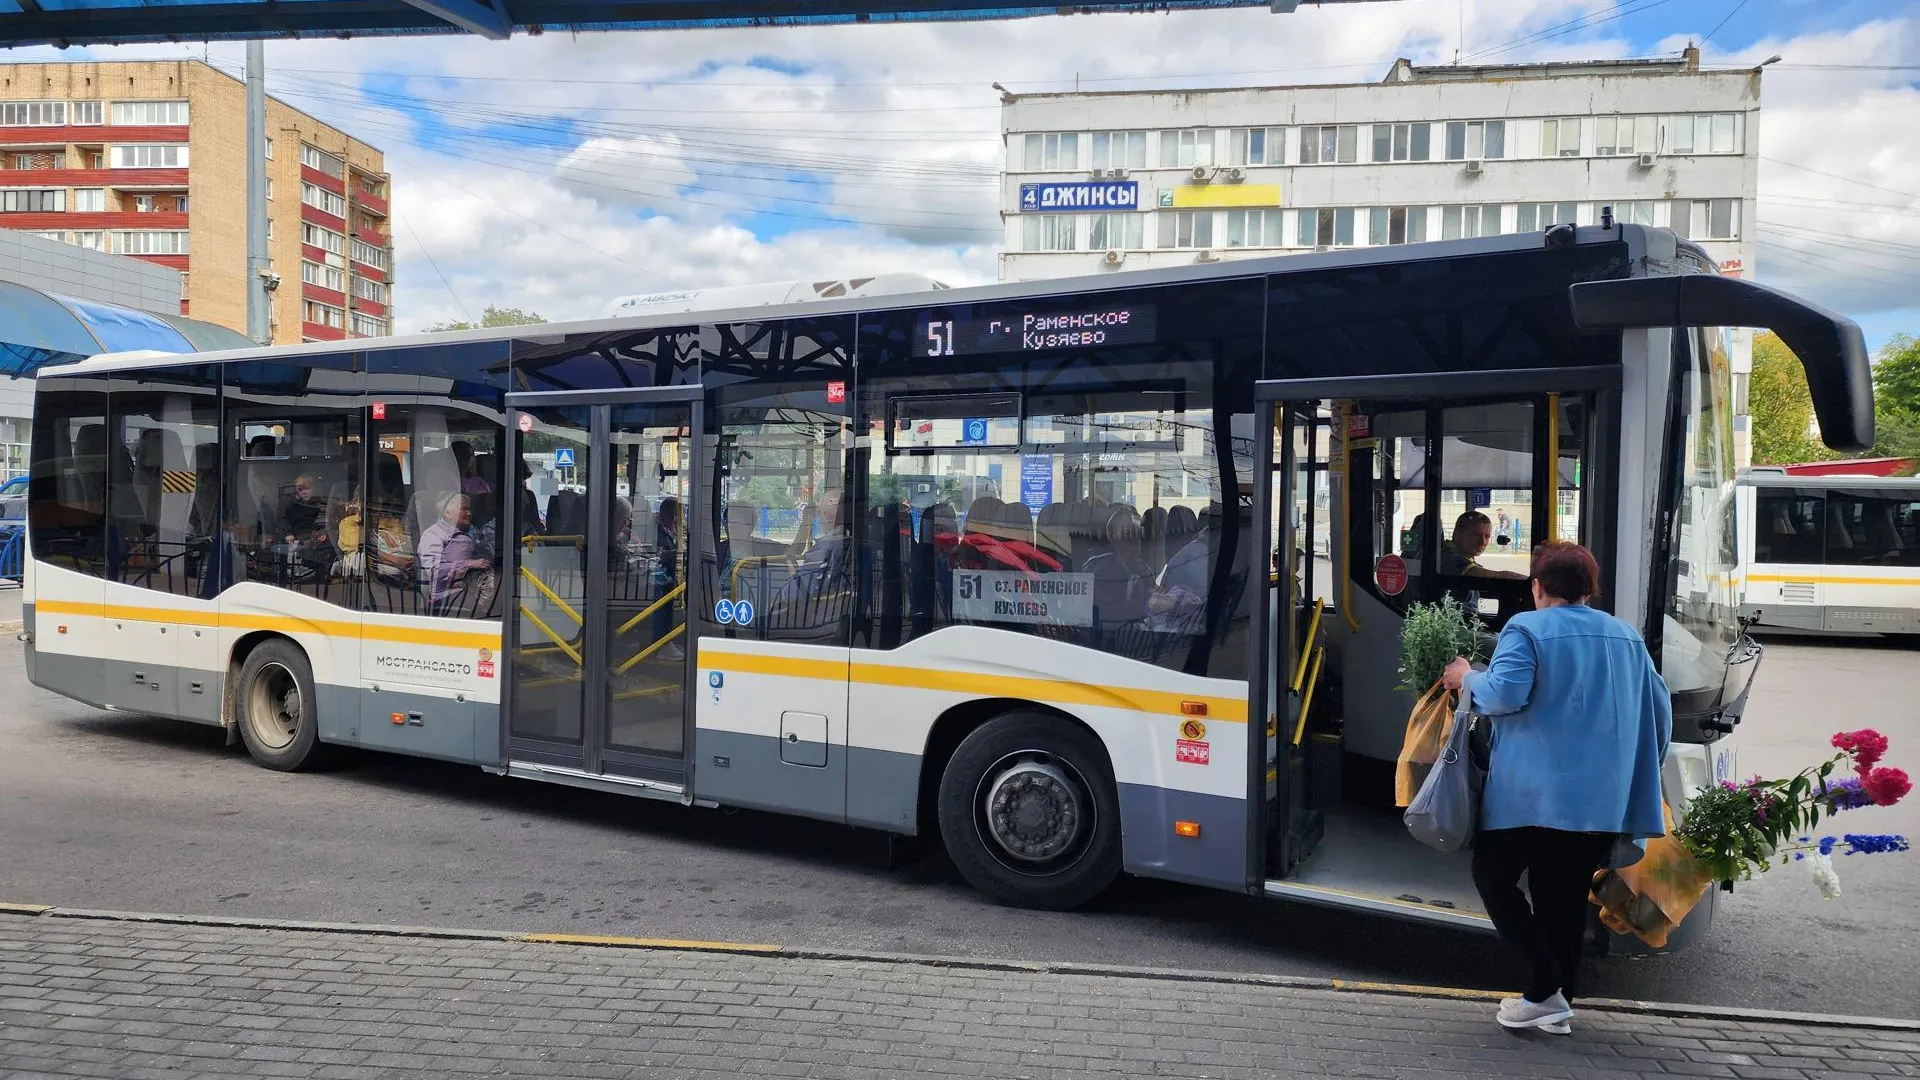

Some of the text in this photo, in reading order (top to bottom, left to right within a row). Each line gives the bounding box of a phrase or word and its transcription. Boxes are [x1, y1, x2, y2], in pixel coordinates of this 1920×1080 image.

[1024, 189, 1036, 204] 4
[1041, 185, 1136, 207] ДЖИНСЫ
[990, 311, 1130, 334] г. Раменское
[927, 320, 954, 356] 51
[1023, 331, 1105, 351] Кузяево
[959, 574, 982, 600] 51
[1014, 579, 1088, 596] РАМЕНСКОЕ
[376, 655, 471, 675] МОСТРАНСАВТО
